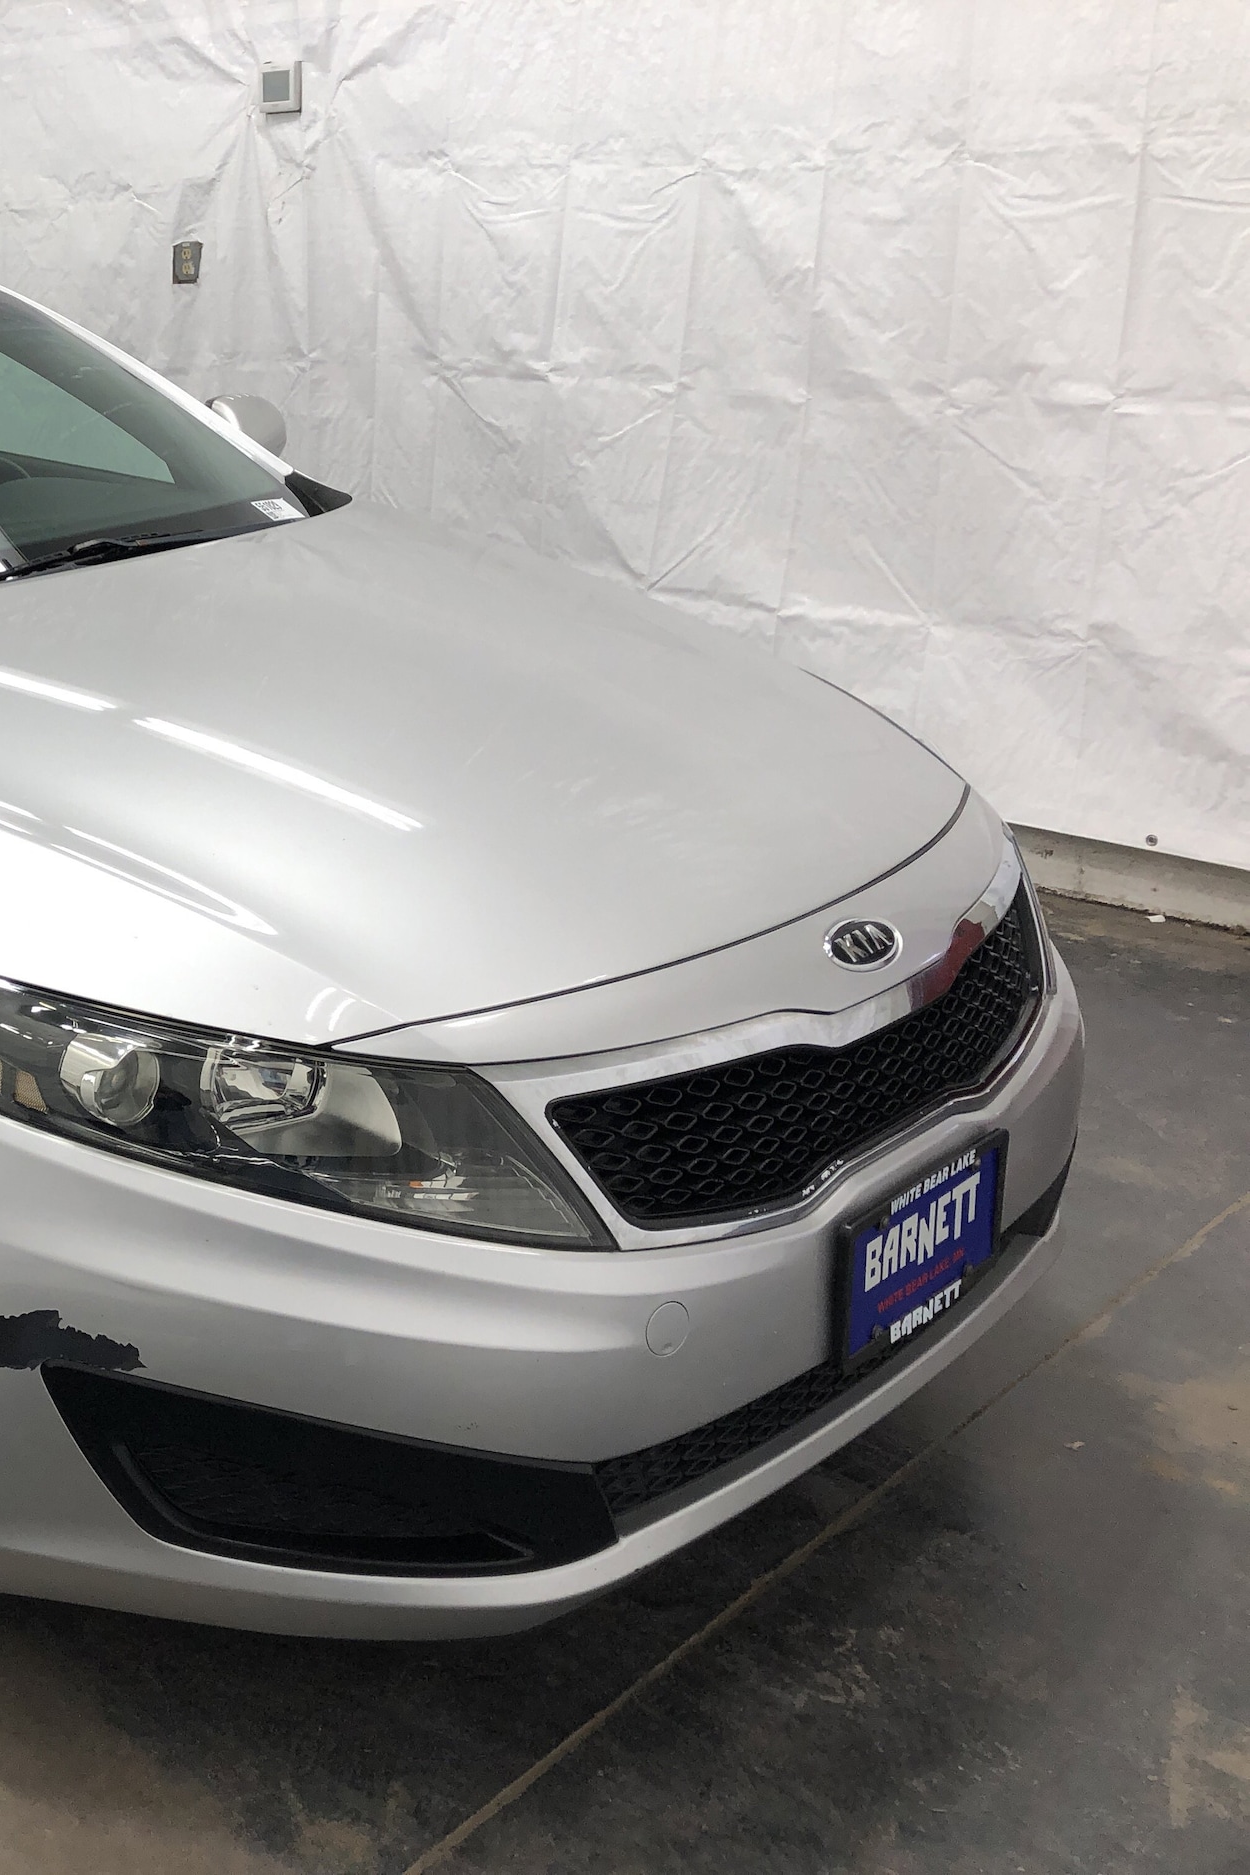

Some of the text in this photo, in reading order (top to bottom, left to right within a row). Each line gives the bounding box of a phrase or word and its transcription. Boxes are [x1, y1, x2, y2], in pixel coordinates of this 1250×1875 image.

[834, 925, 892, 962] KIA
[891, 1149, 976, 1215] WHITE BEAR LAKE
[865, 1172, 980, 1292] BARNETT
[890, 1279, 962, 1344] BARNETT
